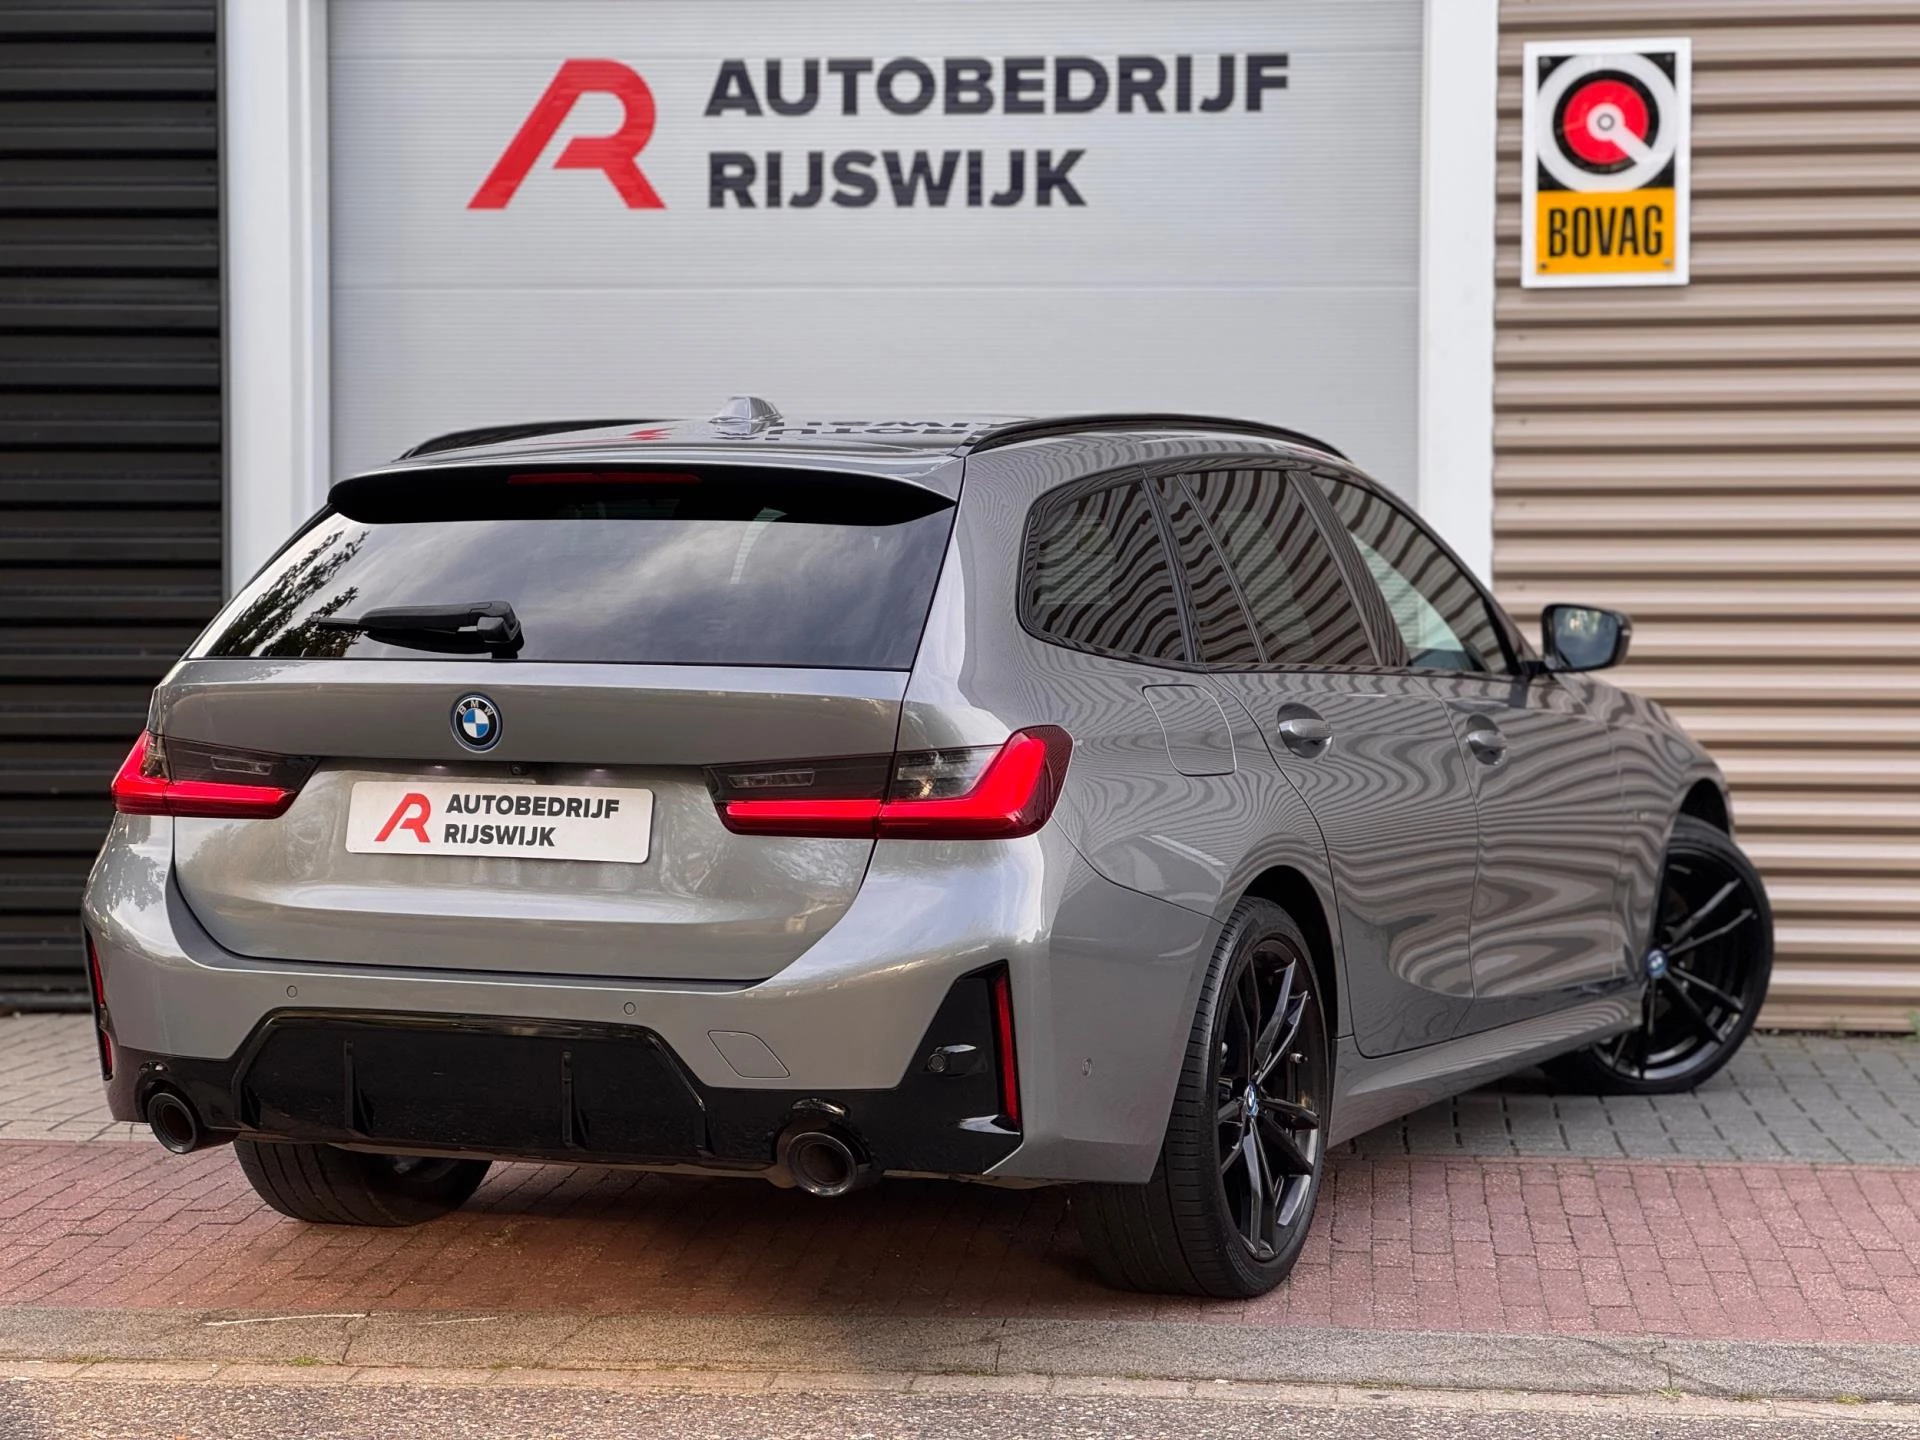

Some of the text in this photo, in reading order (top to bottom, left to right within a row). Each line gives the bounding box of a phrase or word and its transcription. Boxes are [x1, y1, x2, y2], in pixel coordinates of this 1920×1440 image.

[704, 53, 1290, 117] AUTOBEDRIJF
[709, 149, 1087, 208] RIJSWIJK
[1548, 205, 1663, 258] BOVAG
[458, 700, 494, 716] BMW
[445, 793, 620, 819] AUTOBEDRIJF
[443, 823, 556, 847] RIJSWIJK
